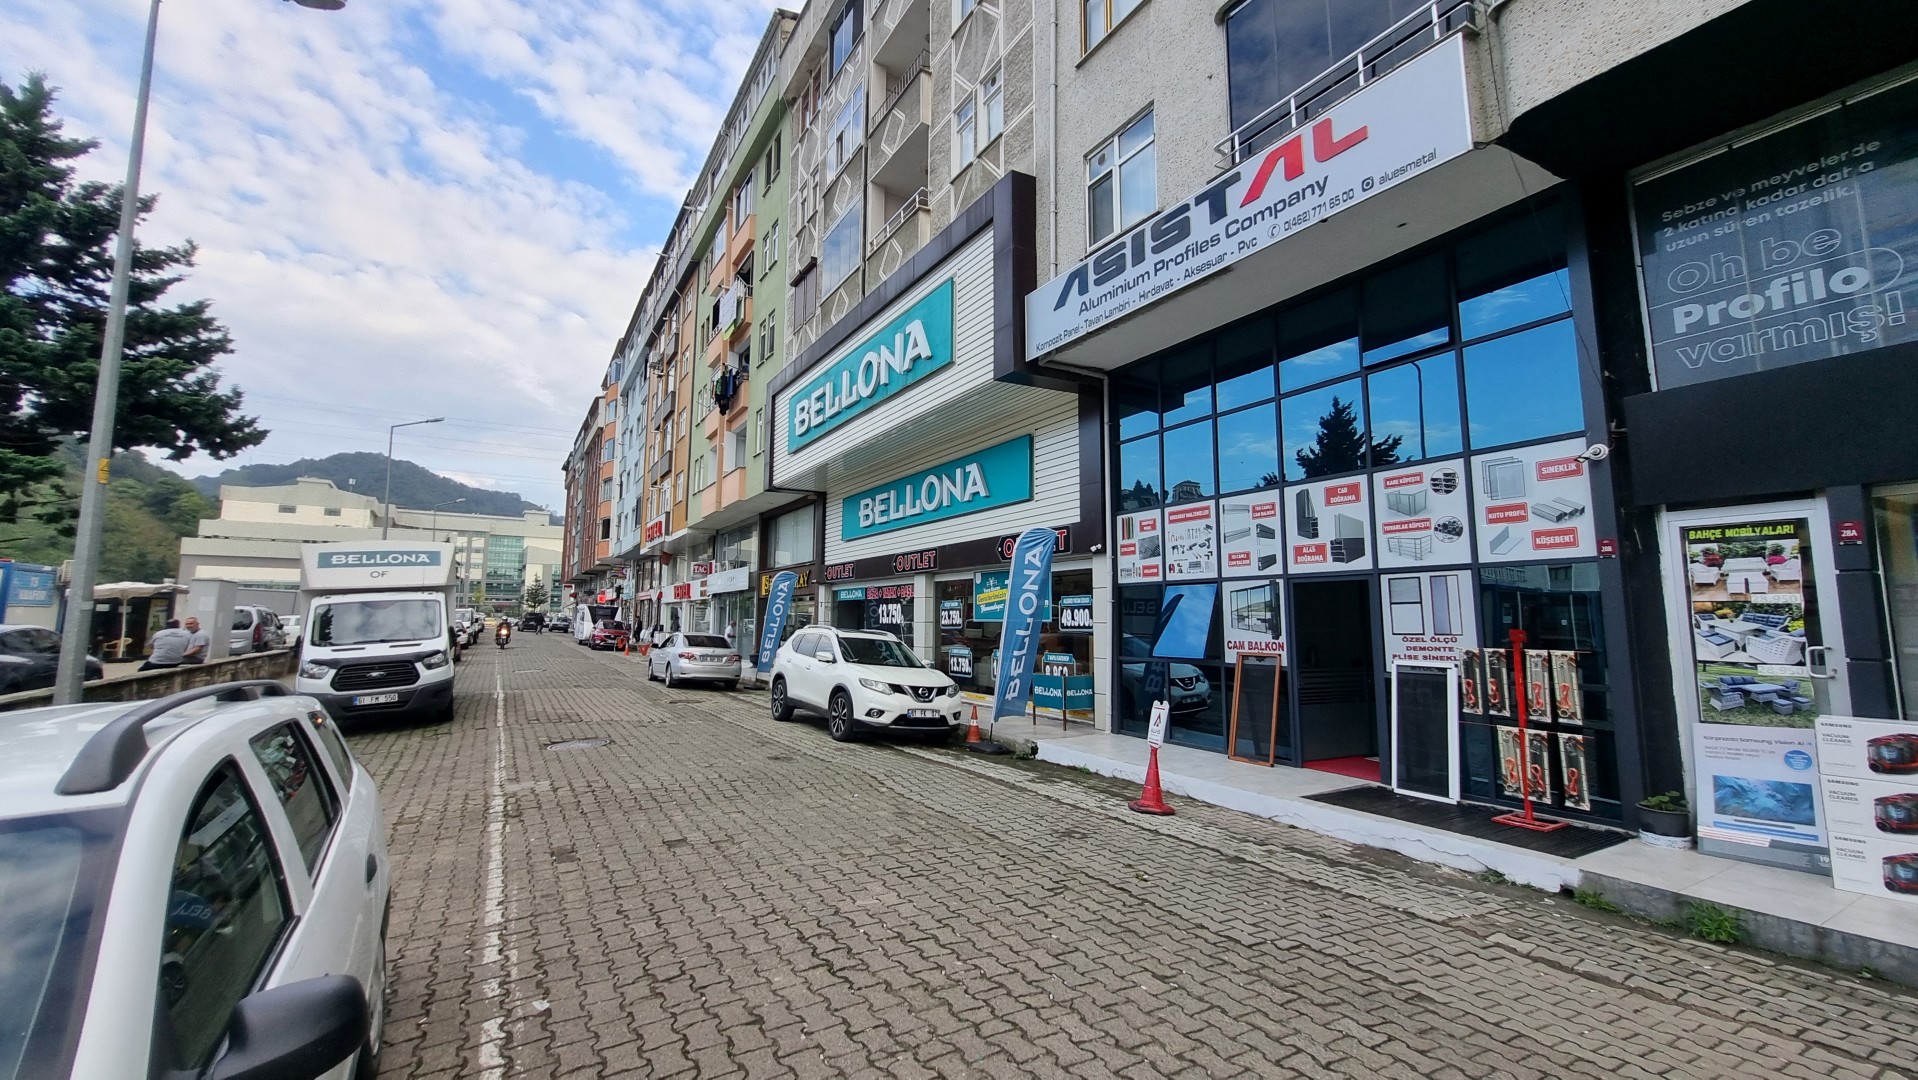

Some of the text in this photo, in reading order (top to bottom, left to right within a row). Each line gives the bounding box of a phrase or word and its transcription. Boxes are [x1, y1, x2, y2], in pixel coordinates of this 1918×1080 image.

[1379, 148, 1437, 185] aluesmetal
[1312, 202, 1328, 219] 771
[1661, 197, 1717, 222] Sebze
[1720, 185, 1746, 203] ve
[1664, 227, 1675, 238] 2
[1746, 182, 1807, 212] kadar
[1079, 175, 1329, 316] Aluminium Profiles Company
[1666, 231, 1710, 252] uzun
[1761, 228, 1842, 272] be
[1036, 333, 1062, 353] Kompozit
[1063, 323, 1080, 340] Panel
[1084, 314, 1104, 329] Tavan
[1183, 251, 1228, 280] Aksesuar
[1238, 237, 1257, 254] Pvc
[1673, 266, 1870, 335] Profilo
[1676, 290, 1906, 370] varmış!
[794, 319, 932, 436] BELLONA
[858, 462, 990, 528] BELLONA
[1689, 523, 1794, 541] BAHÇE MOBİLYALARI
[1840, 529, 1858, 537] 28A
[331, 554, 430, 565] BELLONA
[896, 550, 936, 572] OUTLET
[370, 570, 389, 579] OF
[826, 563, 854, 580] OUTLET
[840, 589, 863, 599] BELLONA
[761, 580, 790, 664] BELLONA
[1005, 545, 1044, 701] BELLONA
[1227, 640, 1285, 652] CAM BALKON
[1430, 636, 1458, 644] ÖLÇÜ
[1034, 685, 1062, 697] BELLONA
[1066, 688, 1093, 697] BELLONA
[1740, 737, 1773, 745] Samsung
[1828, 794, 1859, 802] CLEANER
[1835, 847, 1865, 855] VACUUM
[1836, 851, 1866, 860] CLEANER
